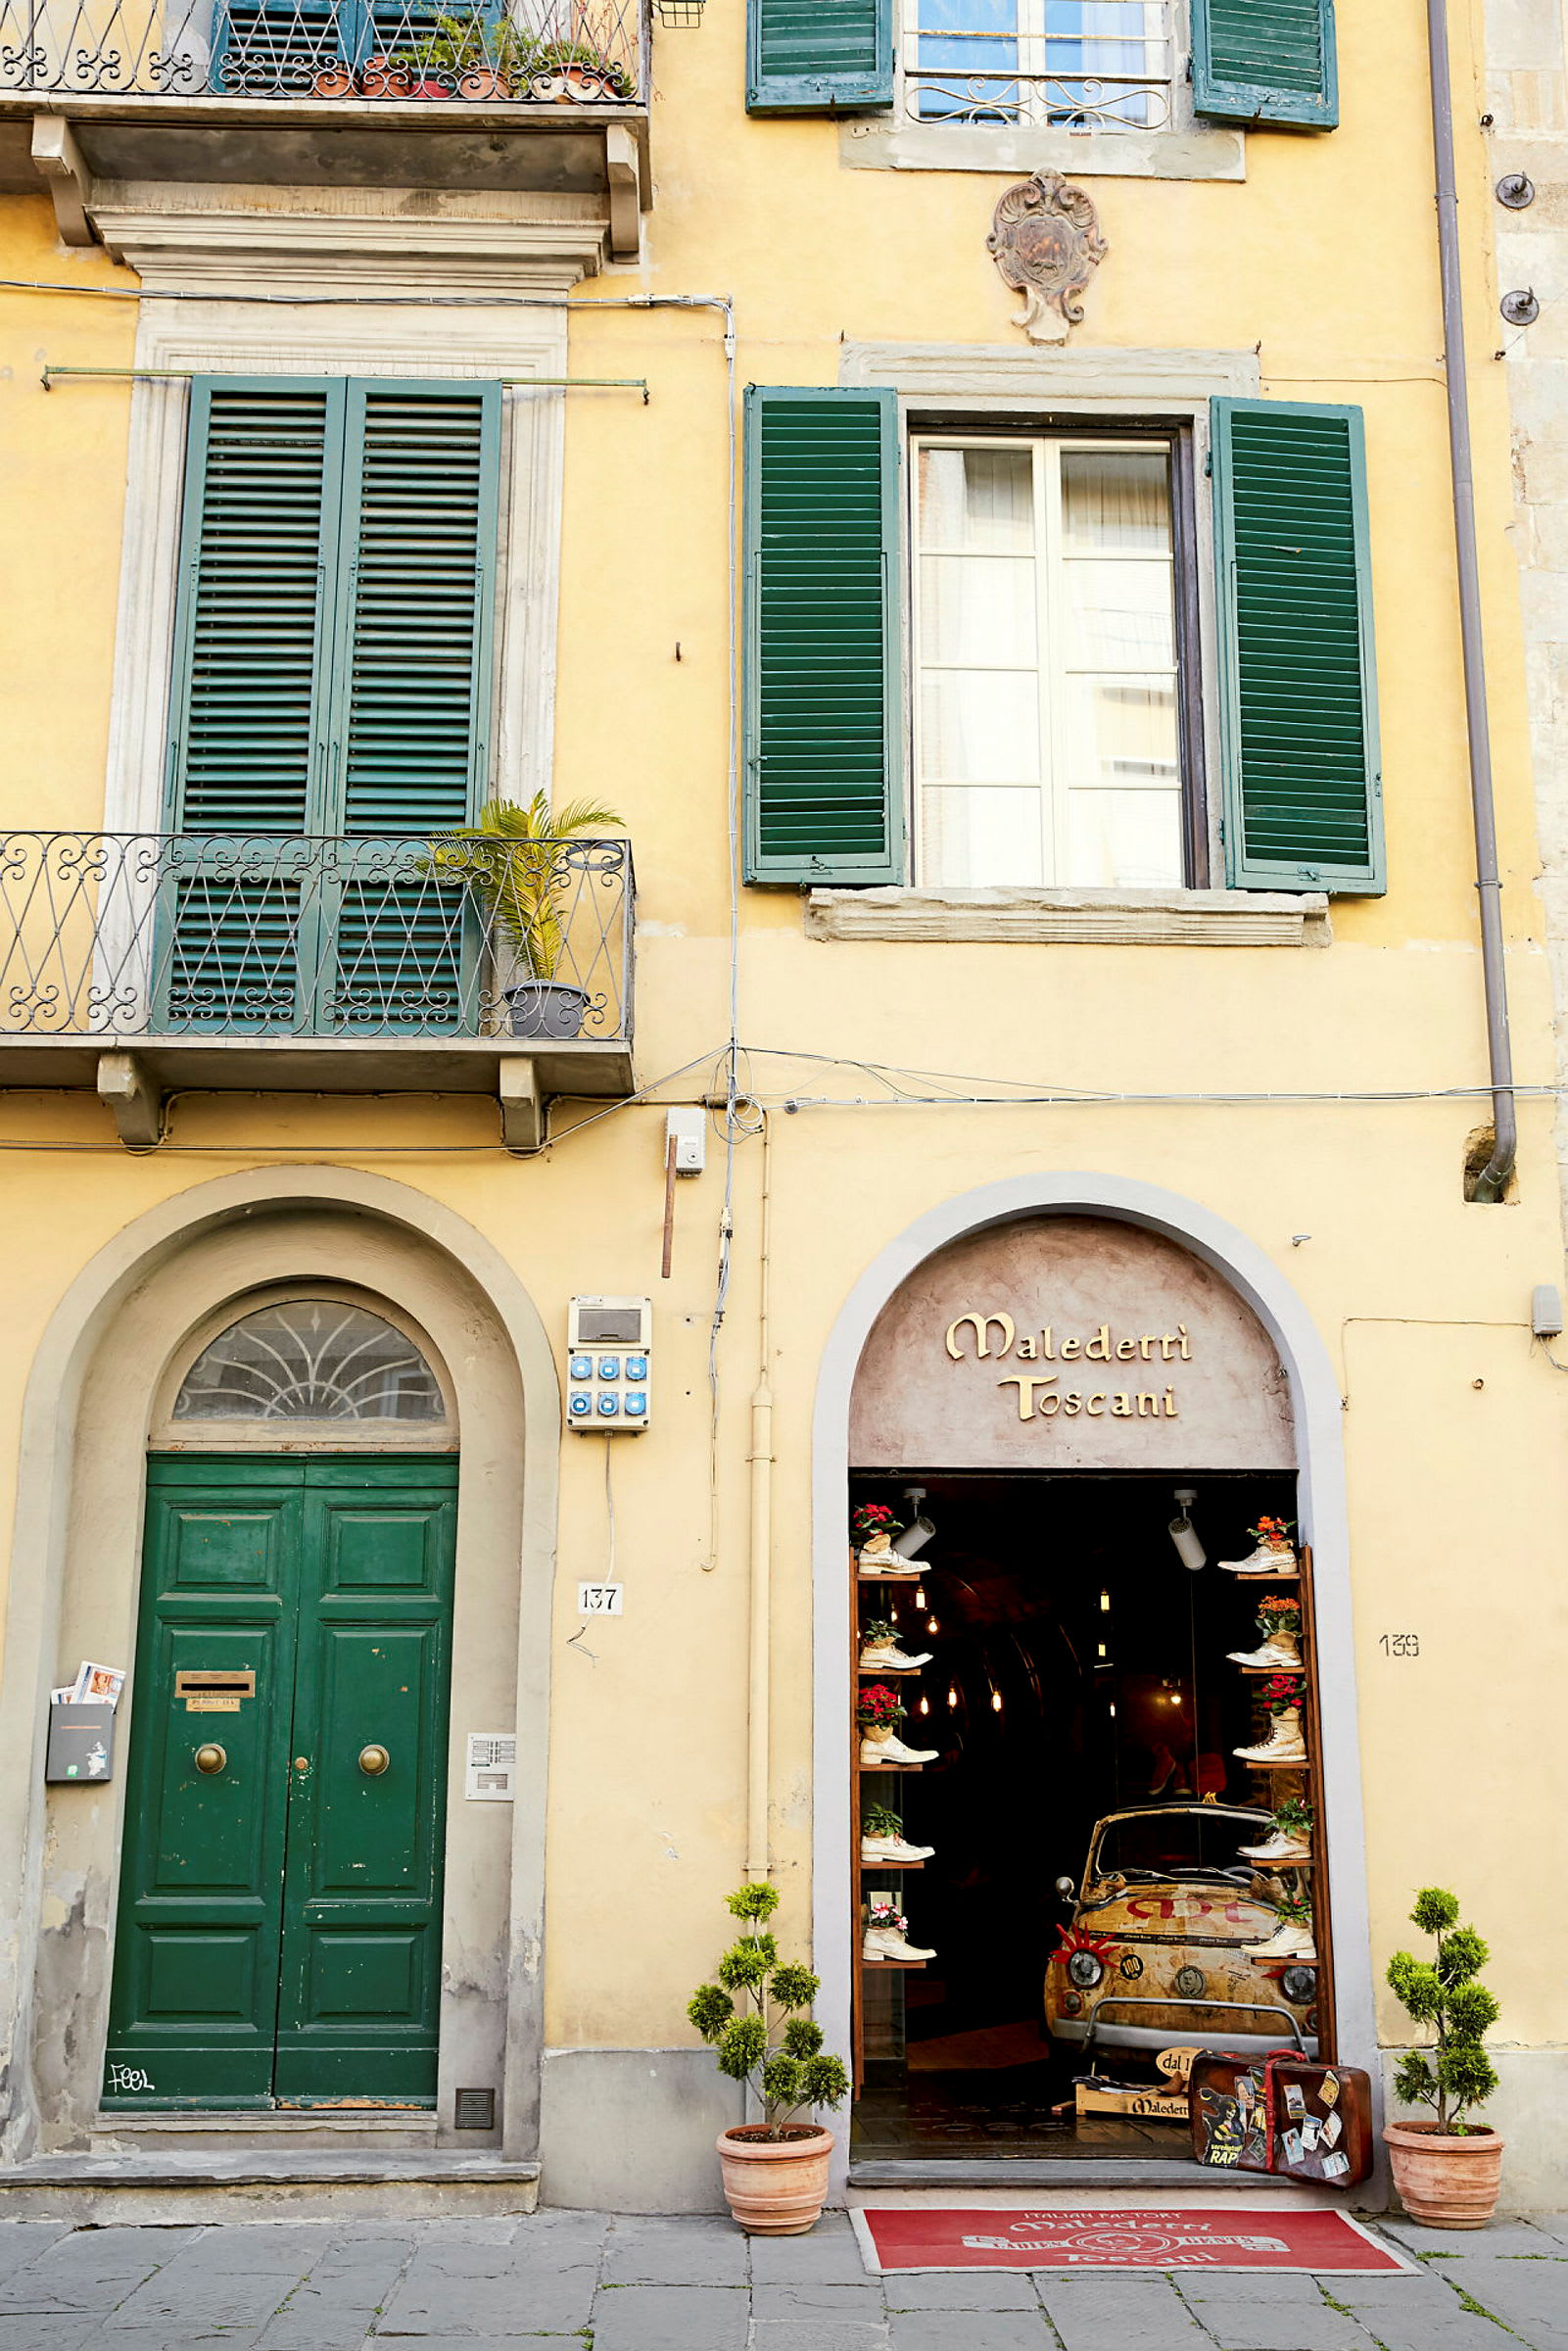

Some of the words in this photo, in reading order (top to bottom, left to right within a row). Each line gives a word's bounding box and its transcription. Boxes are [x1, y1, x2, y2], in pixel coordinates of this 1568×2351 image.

[997, 1374, 1178, 1421] Toscani
[582, 1589, 617, 1609] 137
[1379, 1634, 1419, 1656] 139
[1163, 2053, 1181, 2070] dal
[1210, 2150, 1238, 2164] RAP
[1054, 2252, 1221, 2264] Toscani
